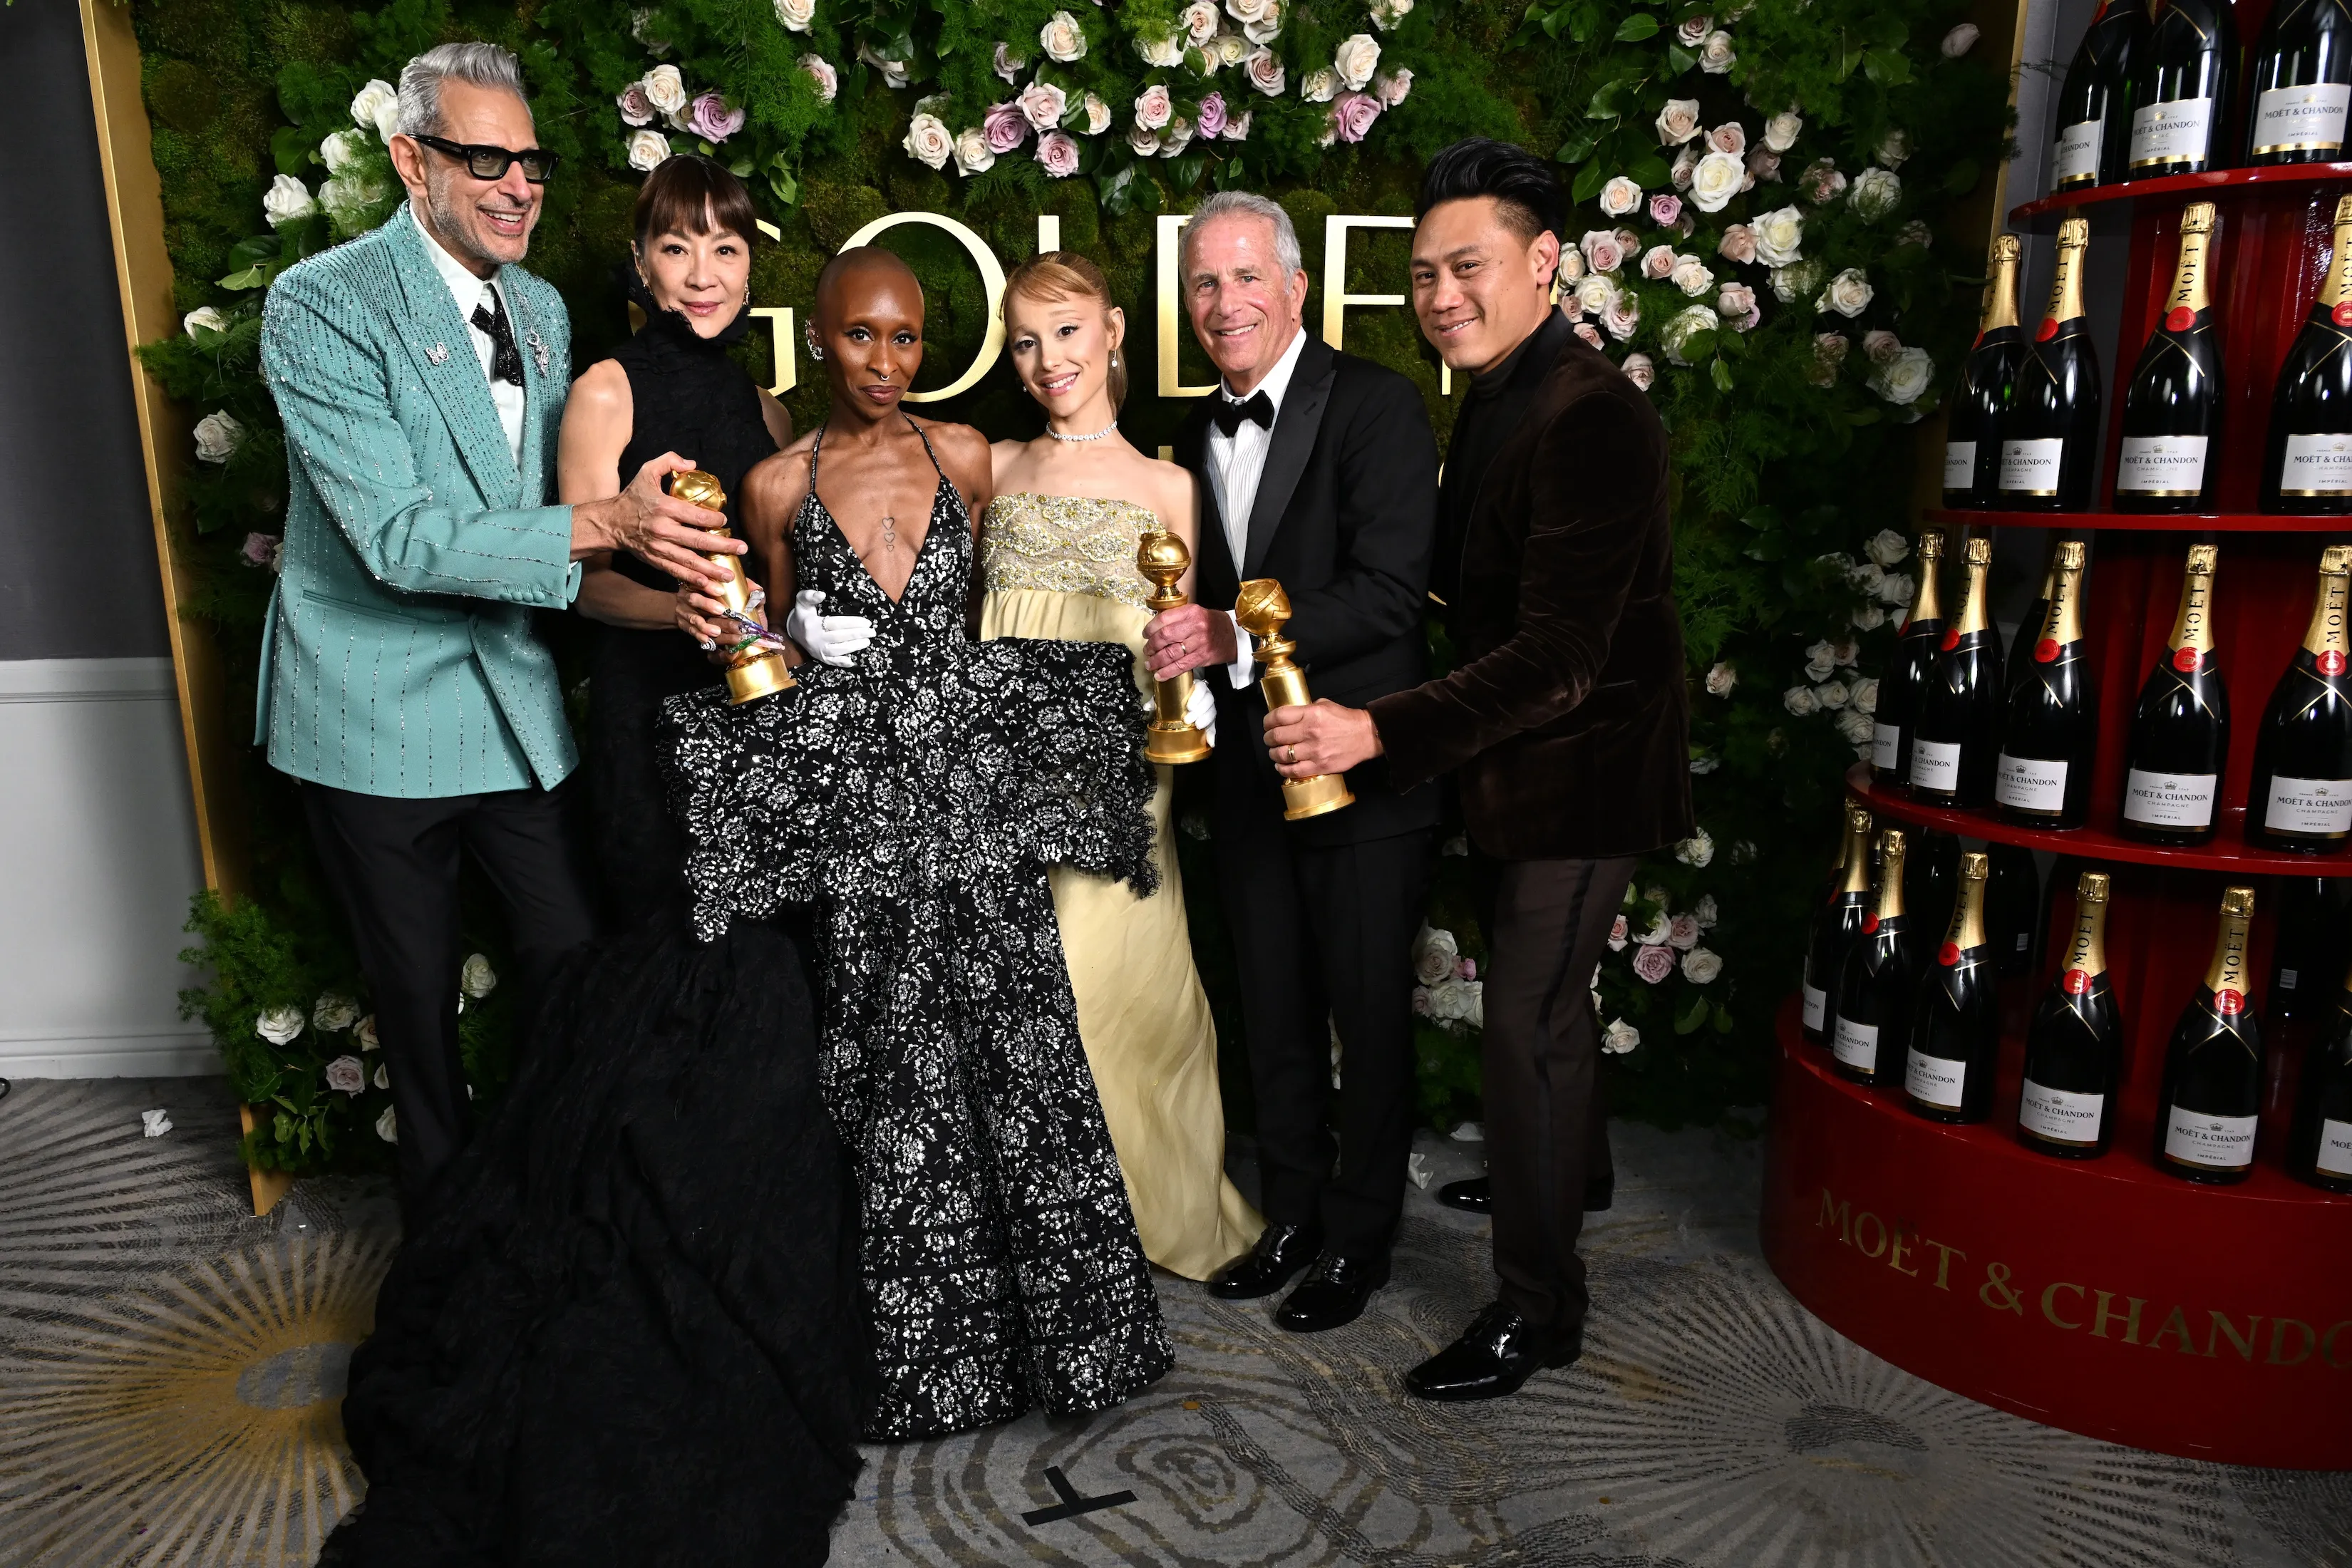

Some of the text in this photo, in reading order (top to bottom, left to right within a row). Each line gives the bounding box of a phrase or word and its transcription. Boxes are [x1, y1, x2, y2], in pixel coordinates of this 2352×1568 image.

[2302, 106, 2343, 115] CHANDON
[2155, 120, 2200, 131] CHANDON
[2177, 245, 2199, 301] MOËT
[2294, 455, 2322, 463] MOËT
[2184, 585, 2205, 641] MOËT
[2326, 587, 2345, 644] MOËT
[1918, 757, 1951, 767] CHANDON
[2016, 776, 2057, 786] CHANDON
[2132, 788, 2155, 798] MOËT
[2276, 797, 2304, 805] MOËT
[2316, 798, 2352, 807] CHANDON
[2223, 928, 2244, 984] MOËT
[1919, 1070, 1956, 1084] CHANDON
[2037, 1112, 2075, 1124] CHAMPAGNE
[2052, 1108, 2095, 1118] CHANDON
[2175, 1126, 2200, 1138] MOËT
[2192, 1140, 2234, 1150] CHAMPAGNE
[2331, 1140, 2352, 1150] MOË
[1816, 1187, 1966, 1291] MOËT
[1979, 1262, 2023, 1317] &
